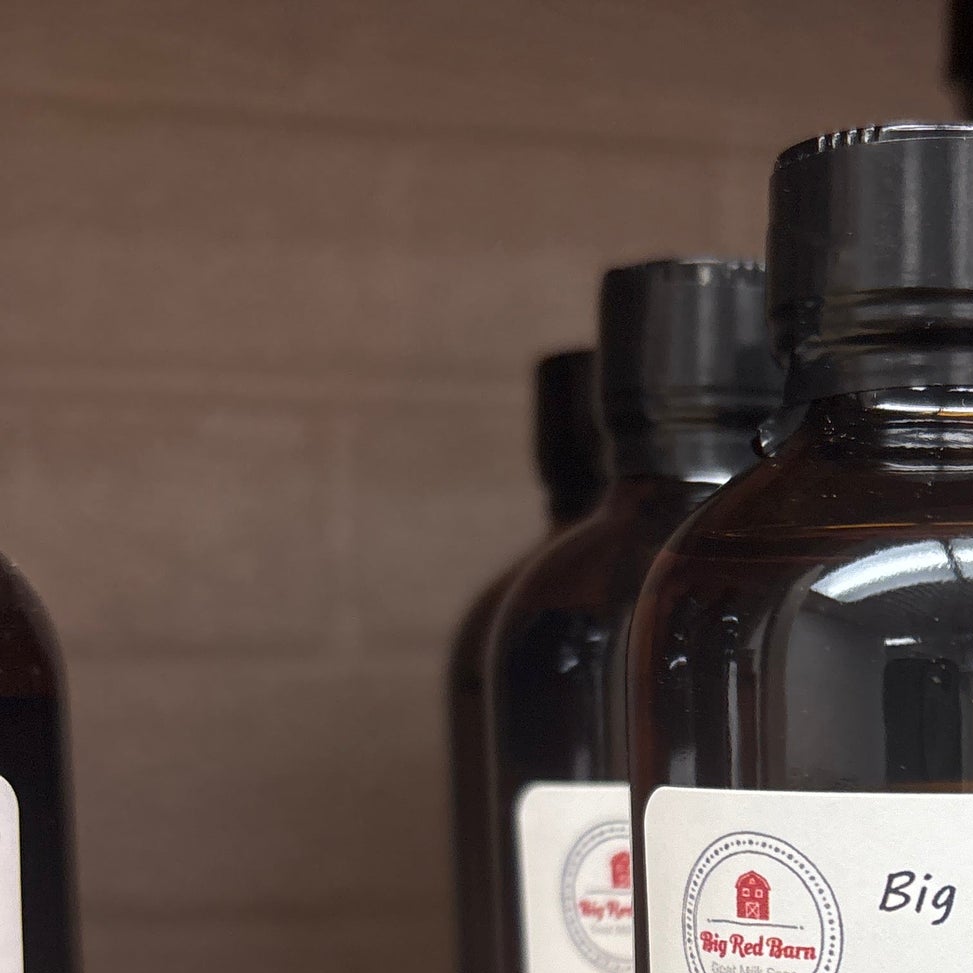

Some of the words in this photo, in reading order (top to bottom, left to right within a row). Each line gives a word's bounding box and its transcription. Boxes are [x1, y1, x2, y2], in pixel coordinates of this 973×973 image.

[879, 869, 956, 925] Big
[700, 931, 727, 958] Big
[729, 934, 764, 958] Red
[766, 937, 817, 960] Barn
